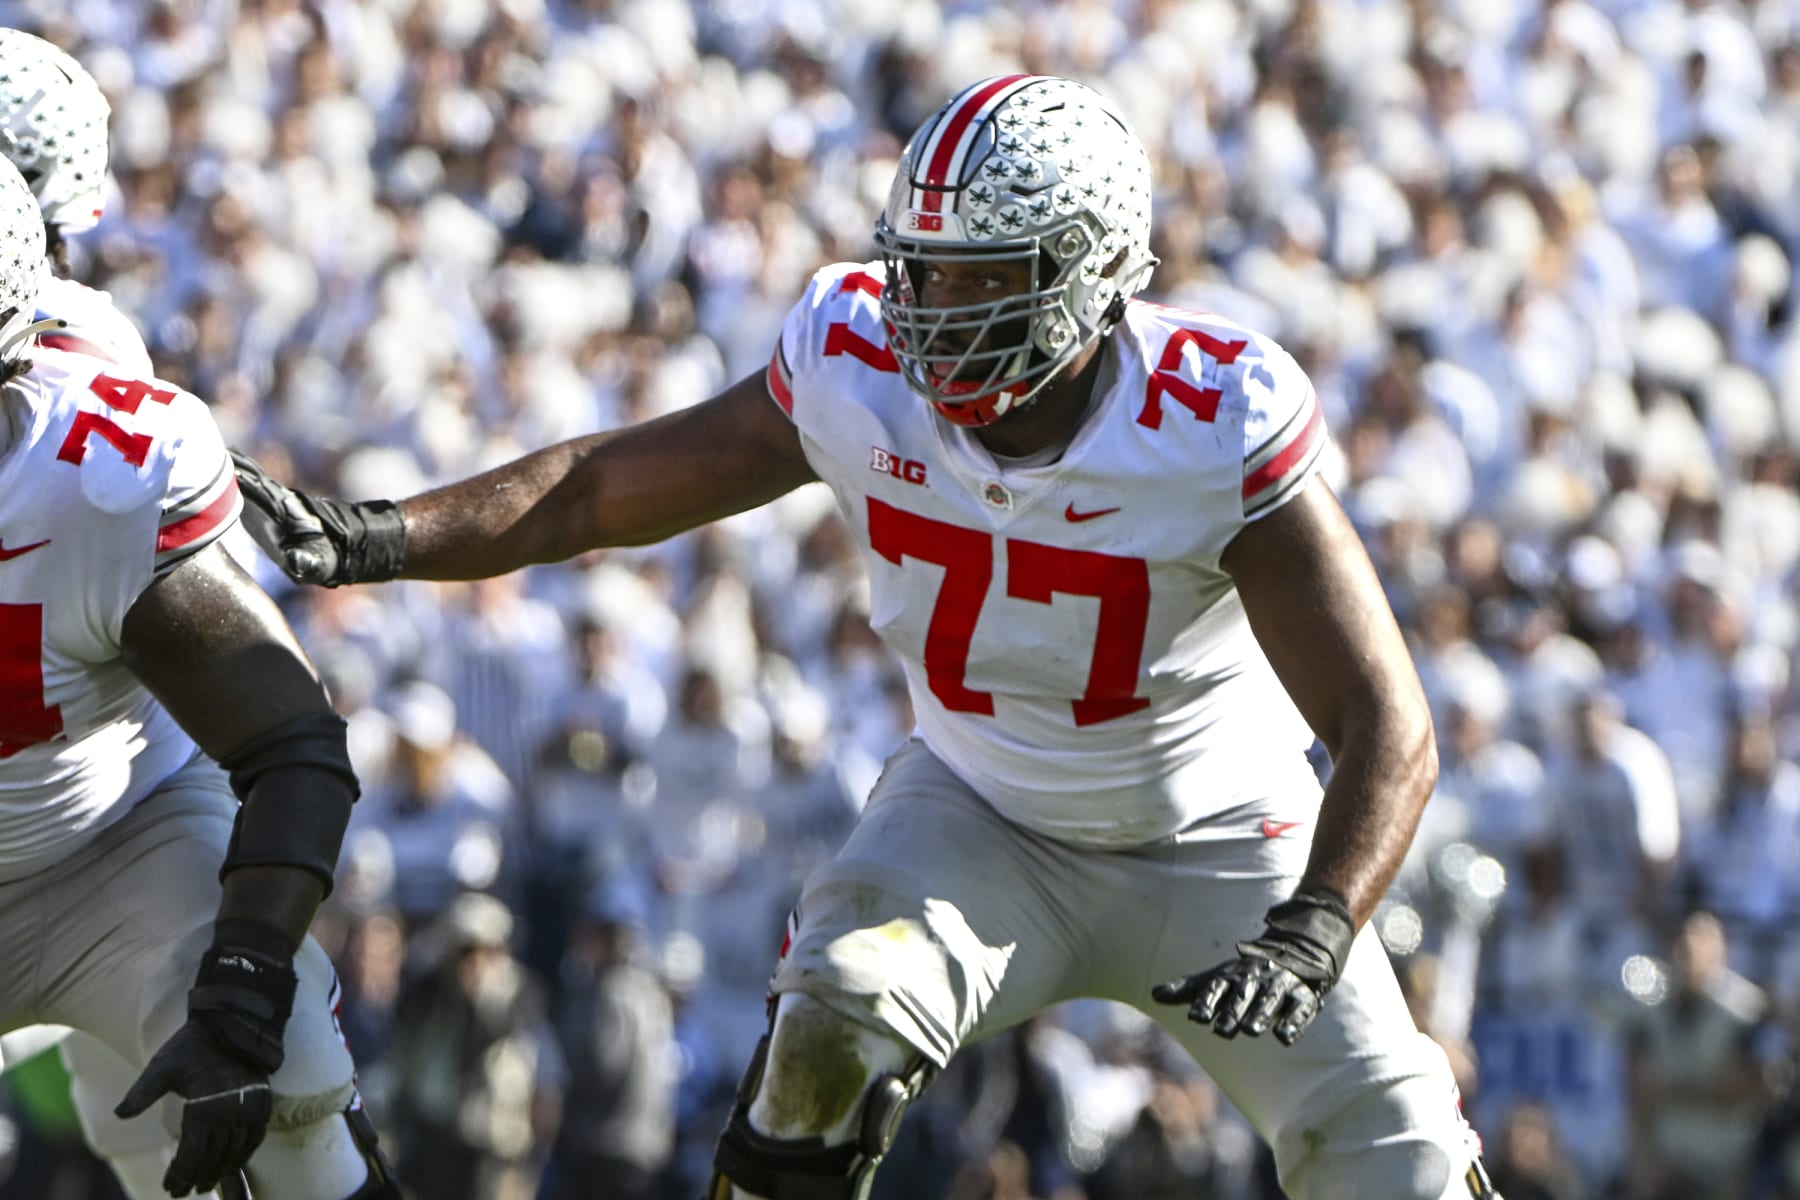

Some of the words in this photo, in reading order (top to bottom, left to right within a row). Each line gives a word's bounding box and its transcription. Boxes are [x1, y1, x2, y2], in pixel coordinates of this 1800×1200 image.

[56, 373, 177, 468] 74
[1135, 327, 1248, 431] 77
[866, 496, 1151, 727] 77
